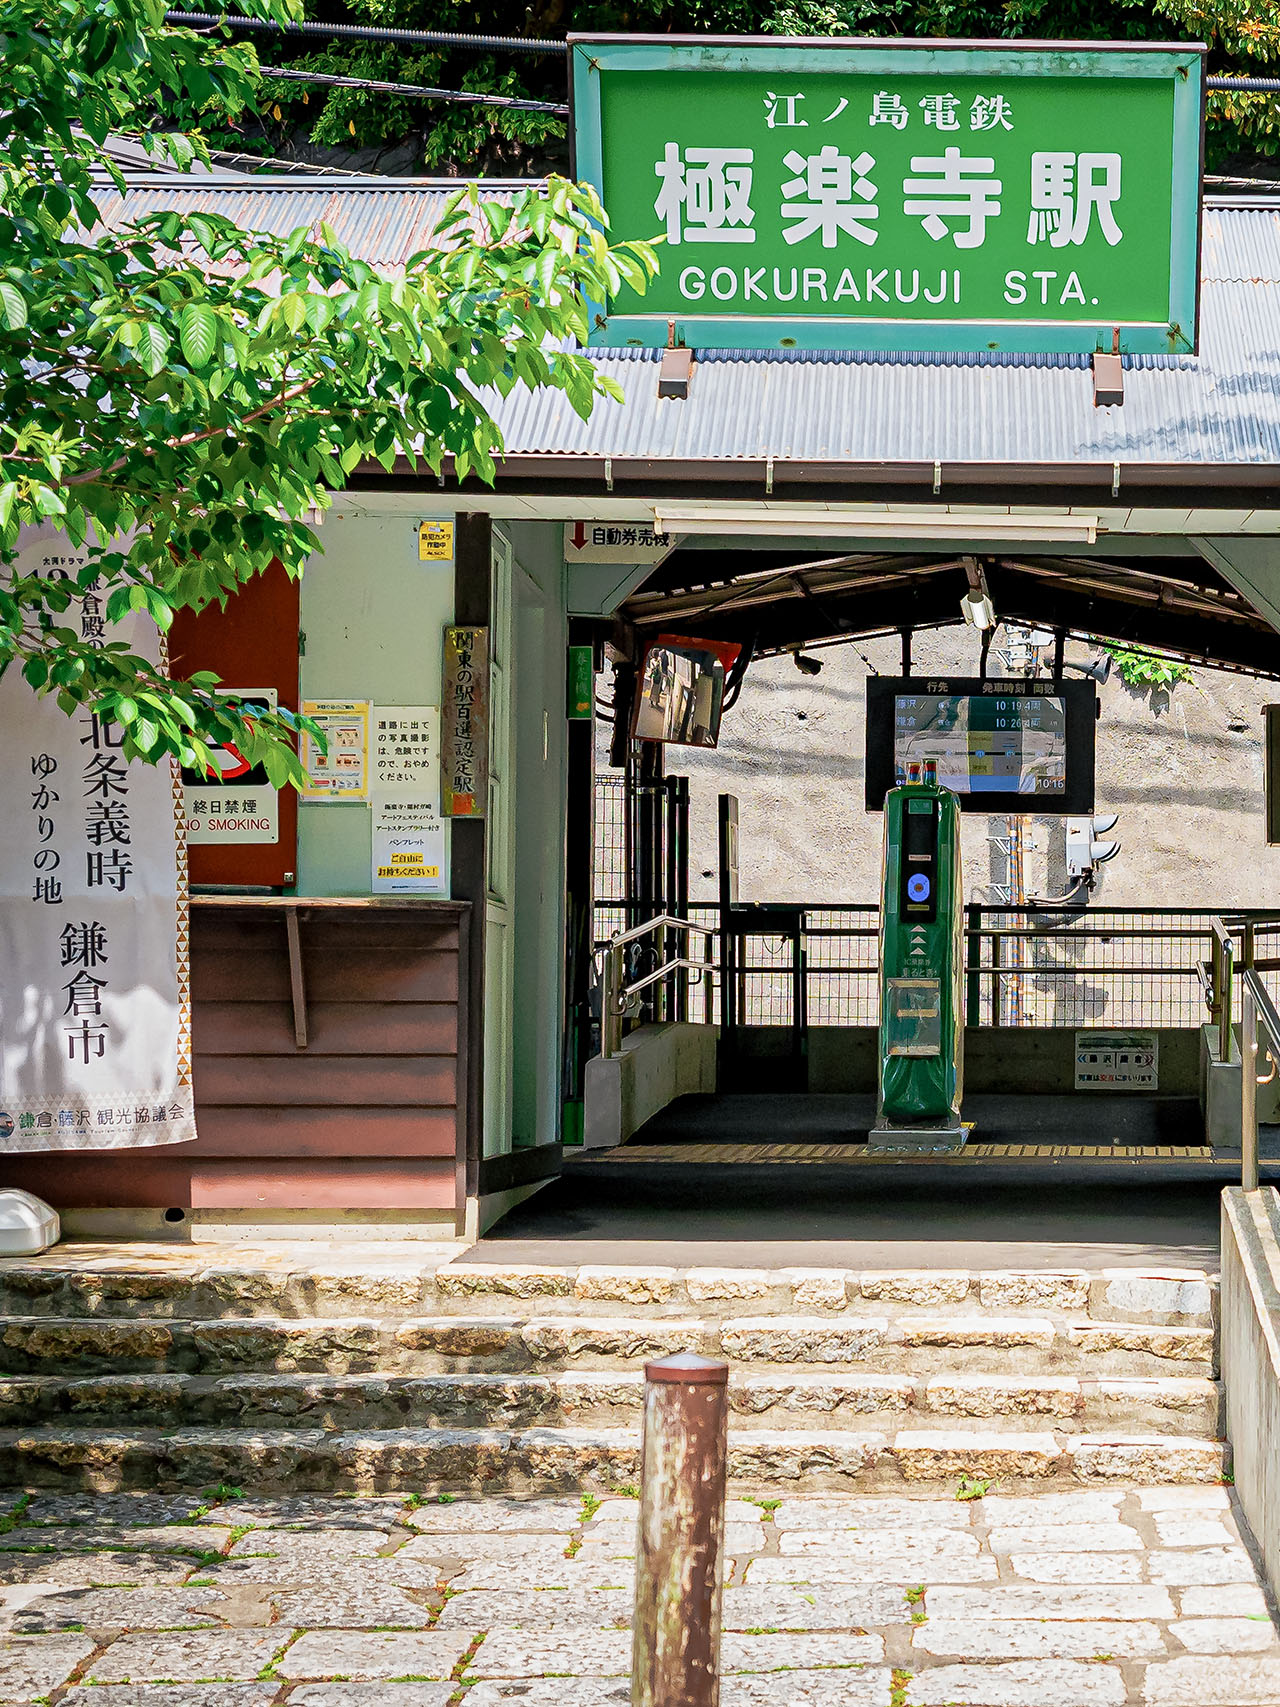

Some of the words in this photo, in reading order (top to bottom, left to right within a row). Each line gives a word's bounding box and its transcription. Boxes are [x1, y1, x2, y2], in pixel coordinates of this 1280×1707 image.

[762, 90, 1015, 132] 江ノ島電鉄
[654, 141, 1123, 249] 極楽寺駅
[679, 266, 960, 303] GOKURAKUJI
[1003, 269, 1099, 305] STA.
[592, 527, 669, 547] 自動券売機
[43, 557, 84, 565] 大河ドラマ
[927, 682, 949, 693] 行先
[453, 631, 475, 794] 関東の駅百選認定駅
[996, 700, 1022, 710] 10:19
[80, 711, 133, 892] 北条義時
[193, 800, 257, 814] 終日禁煙
[31, 753, 63, 904] ゆかりの地
[208, 818, 270, 831] SMOKING
[59, 920, 109, 1064] 鎌倉市
[97, 1103, 185, 1126] 観光協議会
